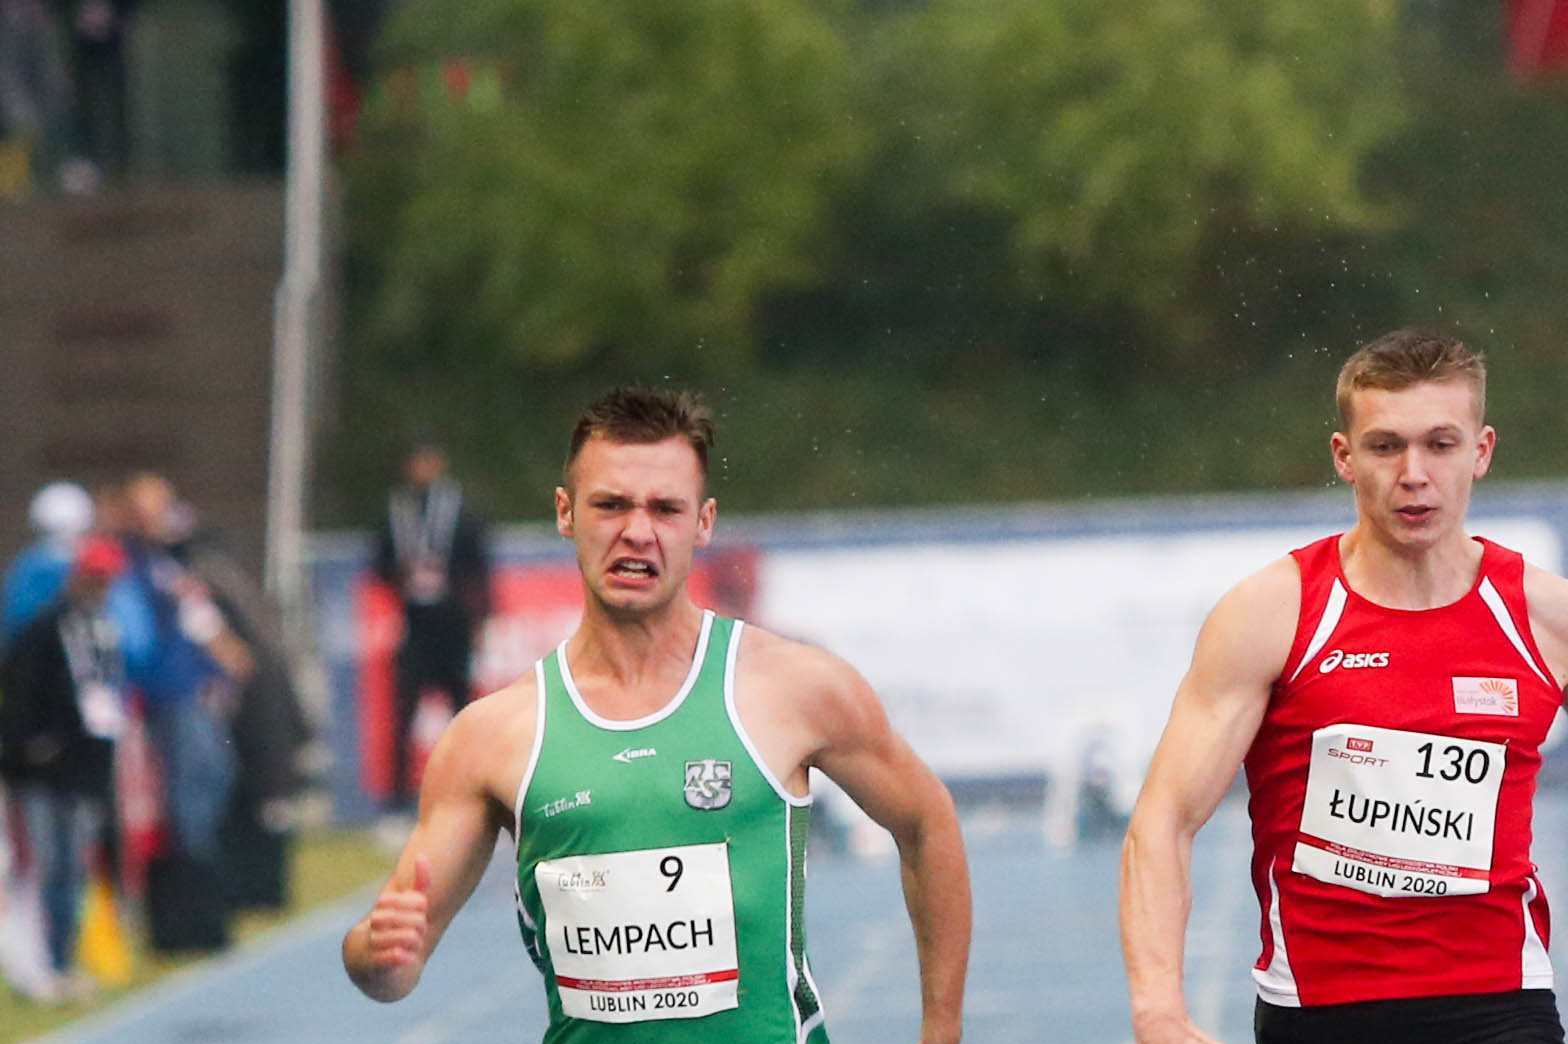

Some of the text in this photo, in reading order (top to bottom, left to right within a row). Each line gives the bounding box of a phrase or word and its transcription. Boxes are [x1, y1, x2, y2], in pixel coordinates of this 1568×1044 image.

[1342, 651, 1390, 669] asics
[1327, 748, 1390, 767] SPORT
[1415, 742, 1490, 784] 130
[1329, 789, 1473, 841] ŁUPIŃSKI
[659, 855, 684, 893] 9
[1334, 860, 1396, 889] LUBLIN
[1401, 876, 1447, 895] 2020
[562, 917, 715, 956] LEMPACH
[590, 991, 699, 1012] LUBLIN 2020
